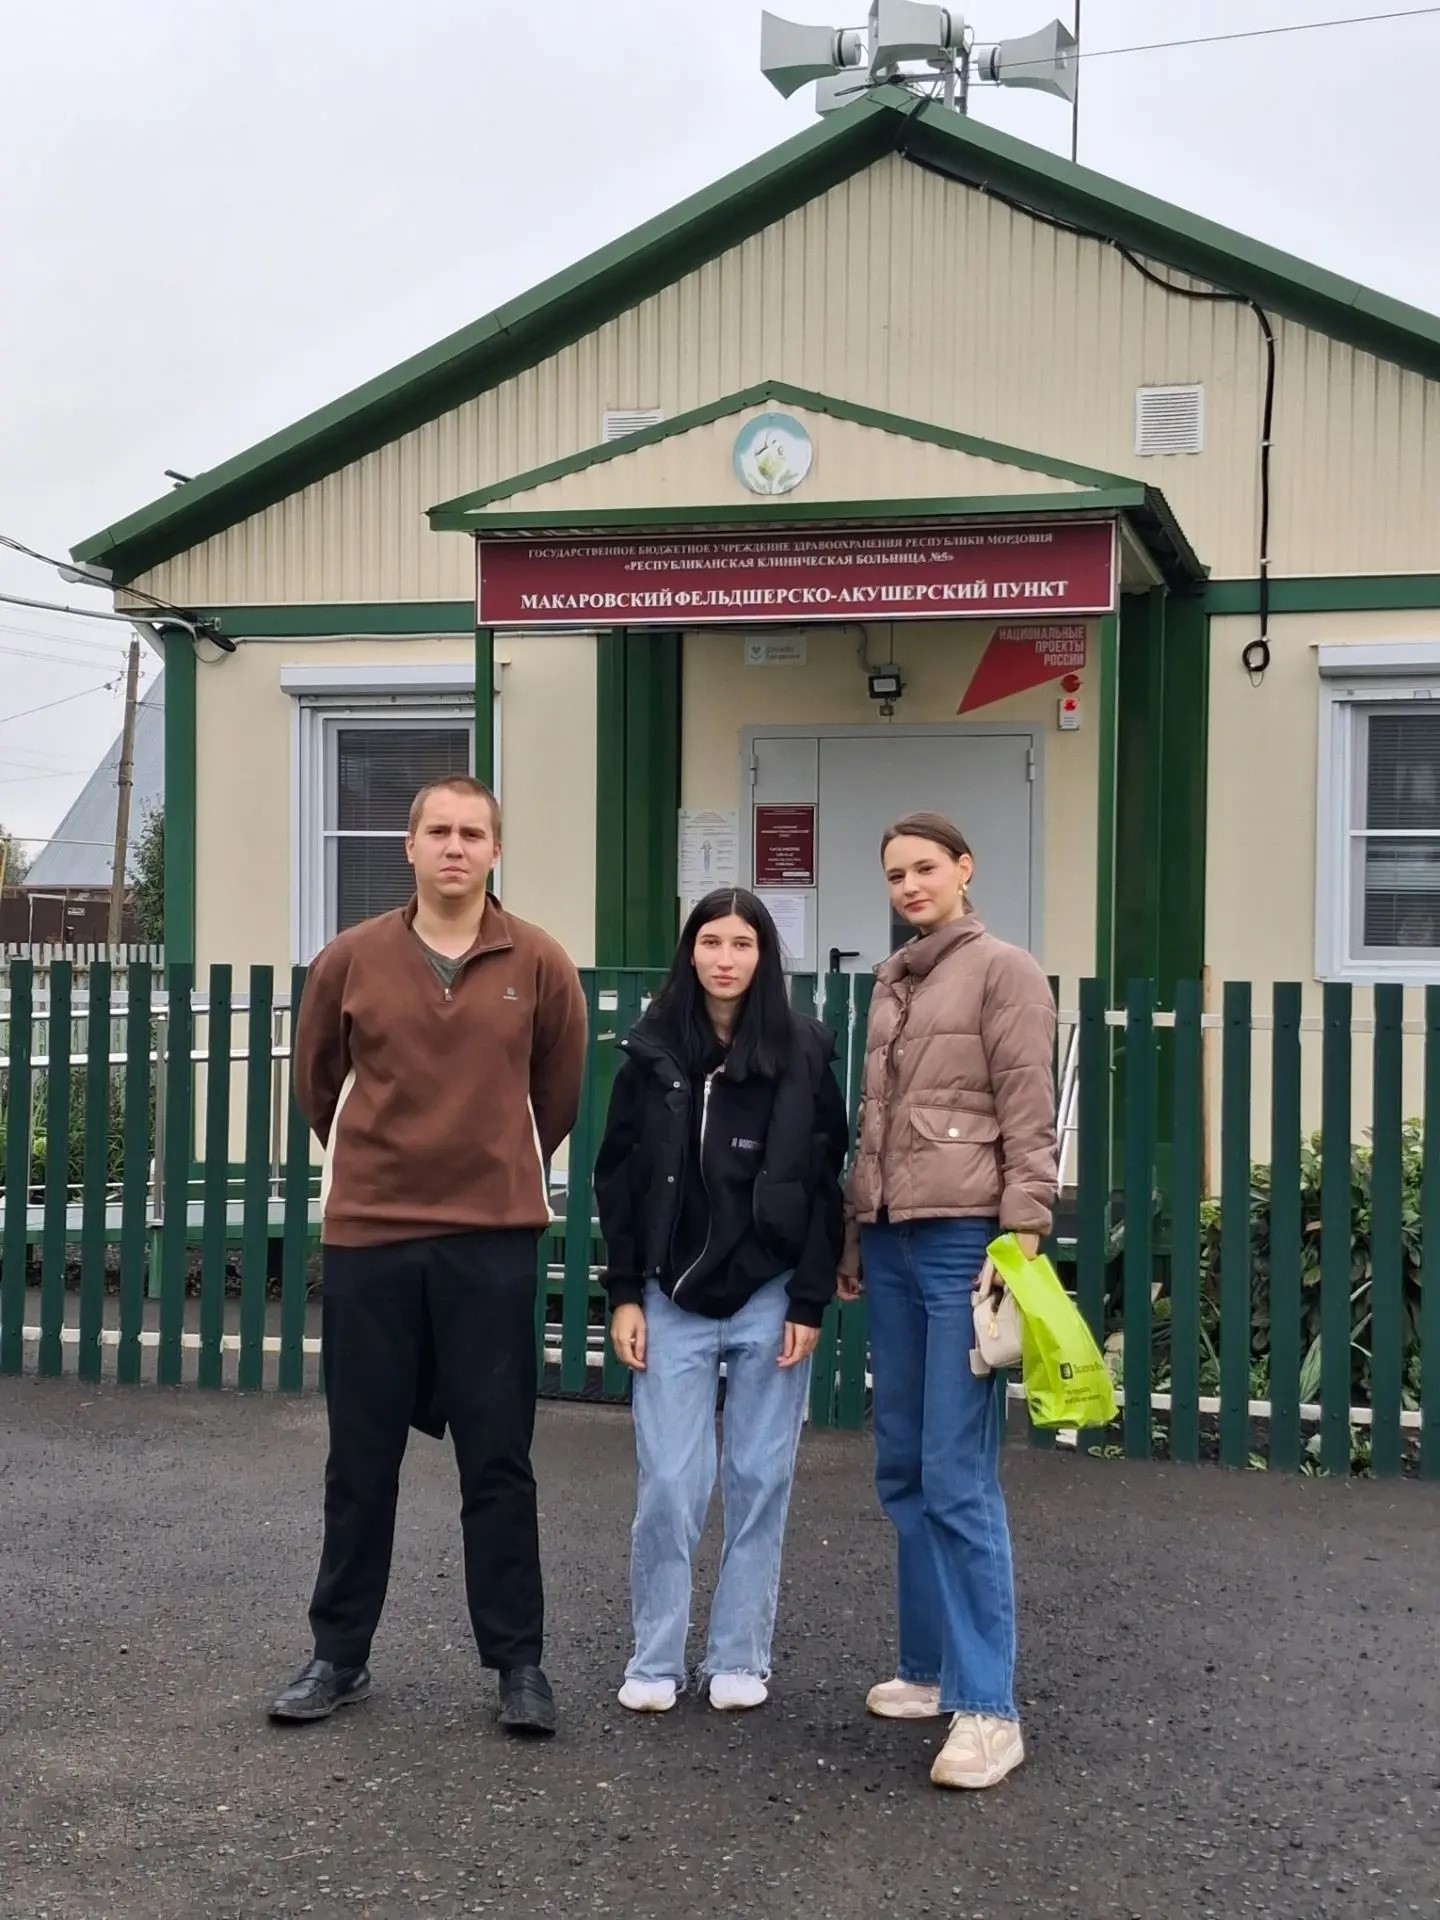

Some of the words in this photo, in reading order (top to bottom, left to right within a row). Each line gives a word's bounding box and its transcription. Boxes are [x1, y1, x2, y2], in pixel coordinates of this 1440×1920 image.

[528, 546, 635, 559] ГОСУДАРСТВЕННОЕ
[638, 543, 710, 555] БЮДЖЕТНОЕ
[713, 541, 790, 553] УЧРЕЖДЕНИЕ
[793, 538, 902, 552] ЗДРАВООХРАНЕНИЯ
[905, 535, 984, 548] РЕСПУБЛИКИ
[987, 533, 1053, 545] МОРДОВИЯ
[624, 558, 754, 571] «РЕСПУБЛИКАНСКАЯ
[757, 555, 852, 568] КЛИНИЧЕСКАЯ
[856, 552, 926, 565] БОЛЬНИЦА
[520, 588, 672, 609] МАКАРОВСКИЙ
[674, 579, 987, 607] ФЕЛЬДШЕРСКО-АКУШЕРСКИЙ
[993, 580, 1068, 598] ПУНКТ
[999, 626, 1084, 641] НАЦИОНАЛЬНЫЕ
[1035, 640, 1084, 653] ПРОЕКТЫ
[1044, 653, 1084, 667] РОССИИ
